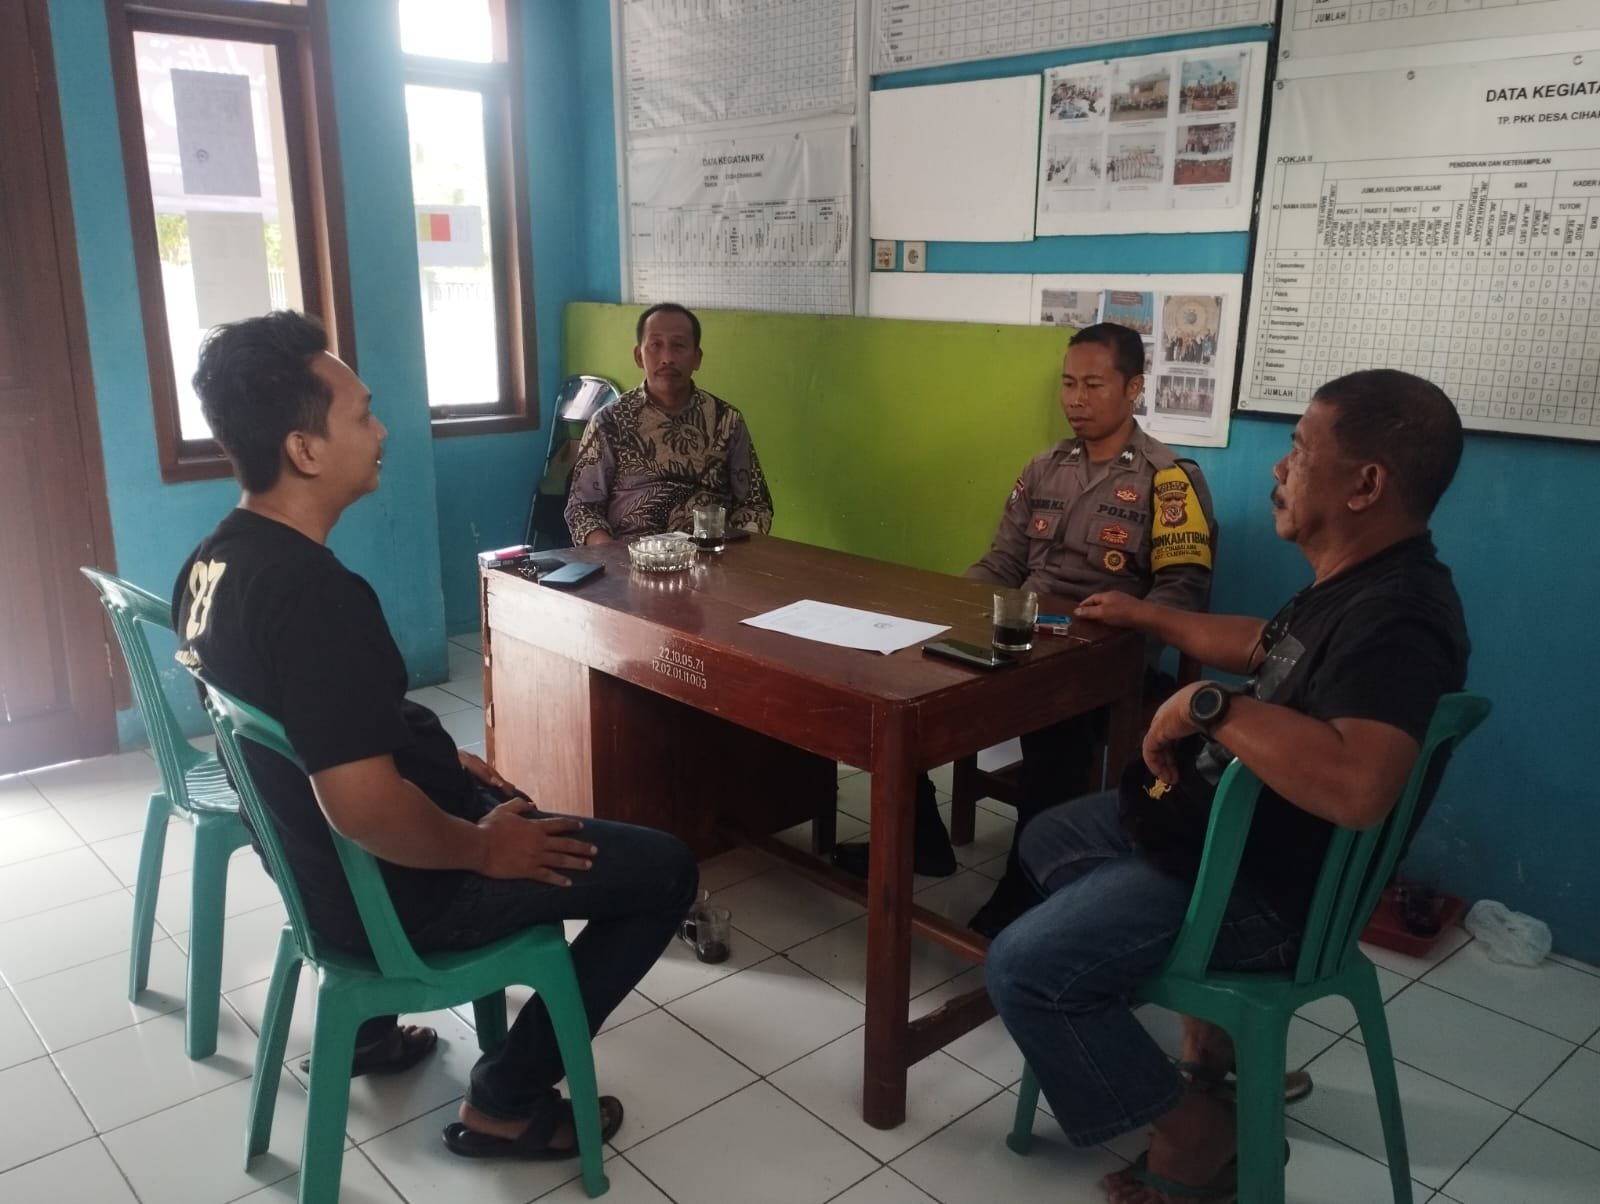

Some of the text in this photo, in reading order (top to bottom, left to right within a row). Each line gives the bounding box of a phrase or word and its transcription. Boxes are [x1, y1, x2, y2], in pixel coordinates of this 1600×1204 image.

[1315, 11, 1346, 22] JUMLAH
[1486, 87, 1528, 102] DATA
[1498, 116, 1510, 124] TP.
[1513, 114, 1535, 124] PKK
[1538, 112, 1568, 122] DESA
[702, 158, 718, 166] DATA
[751, 153, 764, 162] PKK
[1277, 155, 1308, 164] POKJA
[1502, 158, 1551, 166] KETERAMPILAN
[1575, 224, 1584, 240] PAUD
[1097, 504, 1146, 524] POLRI
[659, 645, 704, 672] 22.10.05.71
